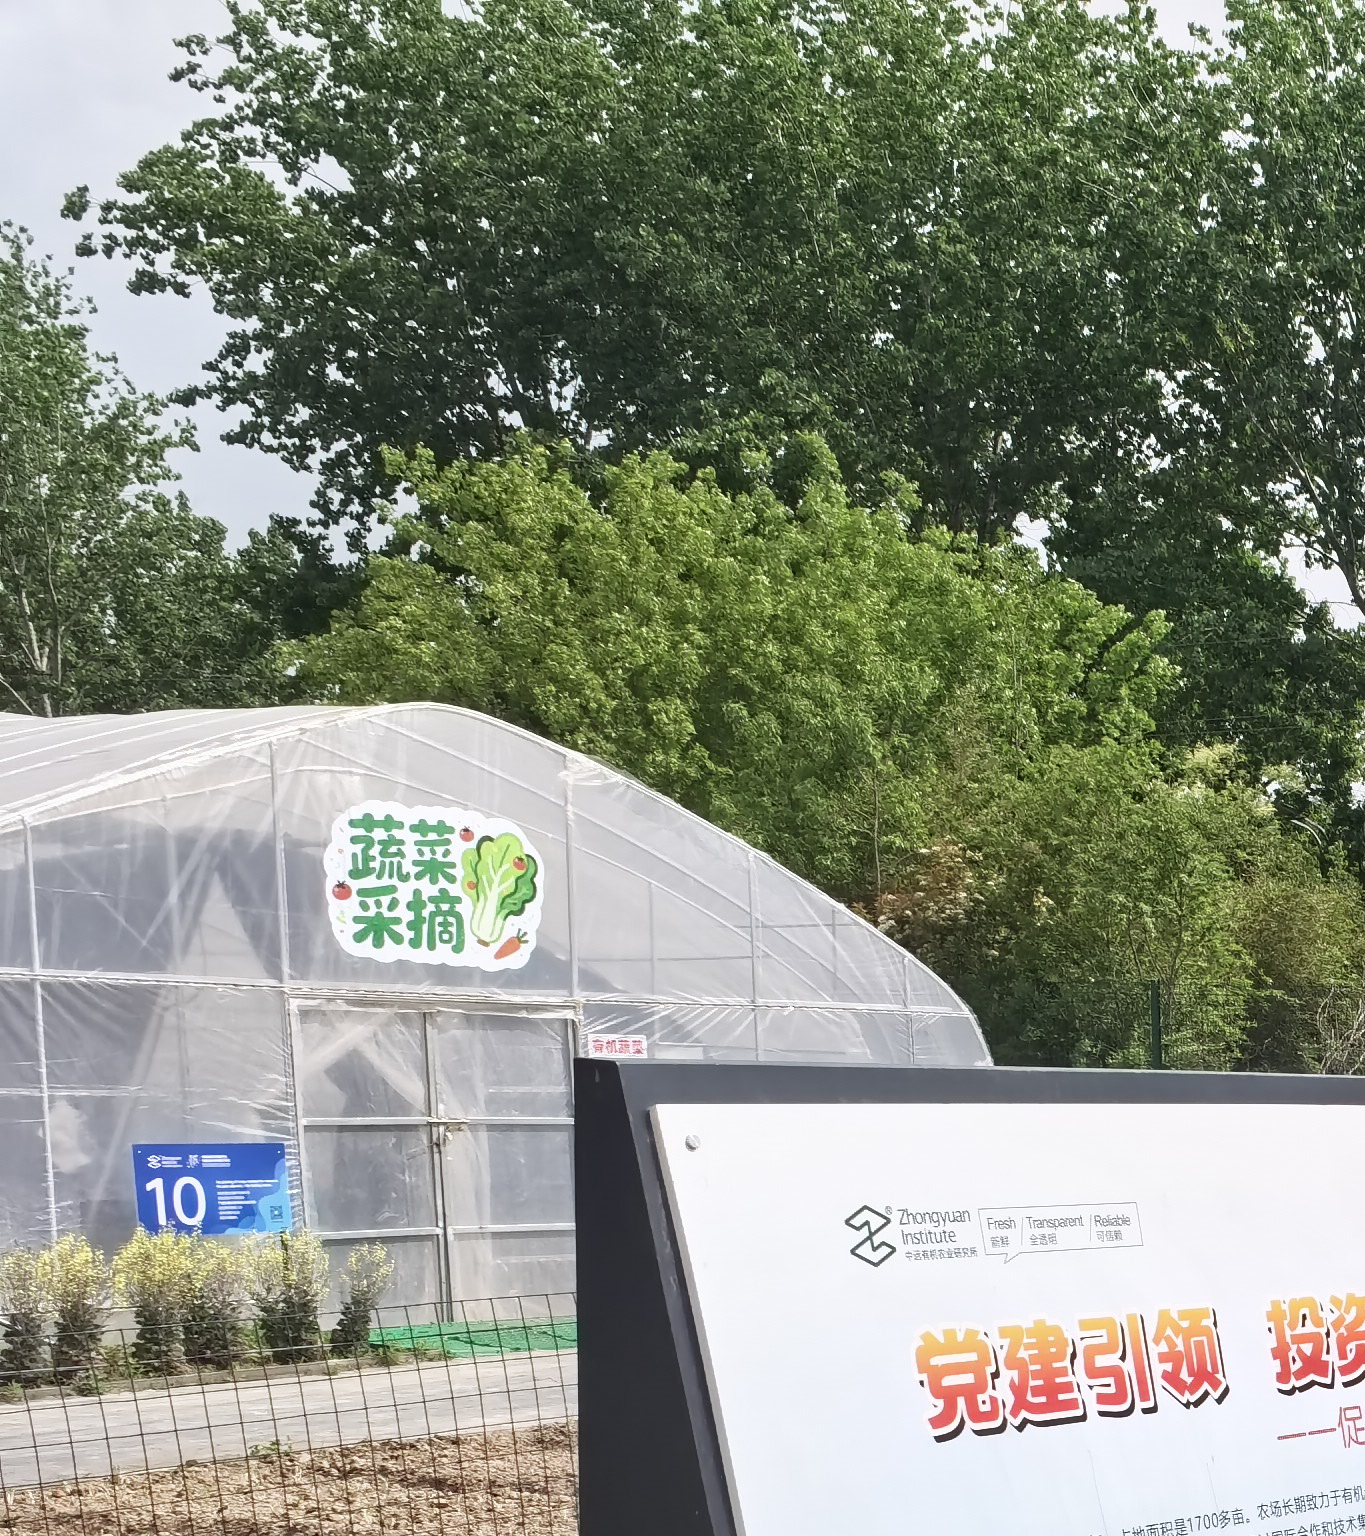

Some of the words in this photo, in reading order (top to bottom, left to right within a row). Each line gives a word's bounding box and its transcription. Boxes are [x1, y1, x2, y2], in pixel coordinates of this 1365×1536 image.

[348, 813, 457, 886] 蔬菜
[352, 885, 465, 953] 采摘
[145, 1176, 206, 1226] 10
[897, 1208, 971, 1227] Zhongyuan
[986, 1216, 1017, 1231] Fresh
[1025, 1213, 1085, 1232] Transparent
[1094, 1213, 1131, 1229] Reliable
[901, 1229, 957, 1245] Institute
[915, 1305, 1229, 1441] 党建引领
